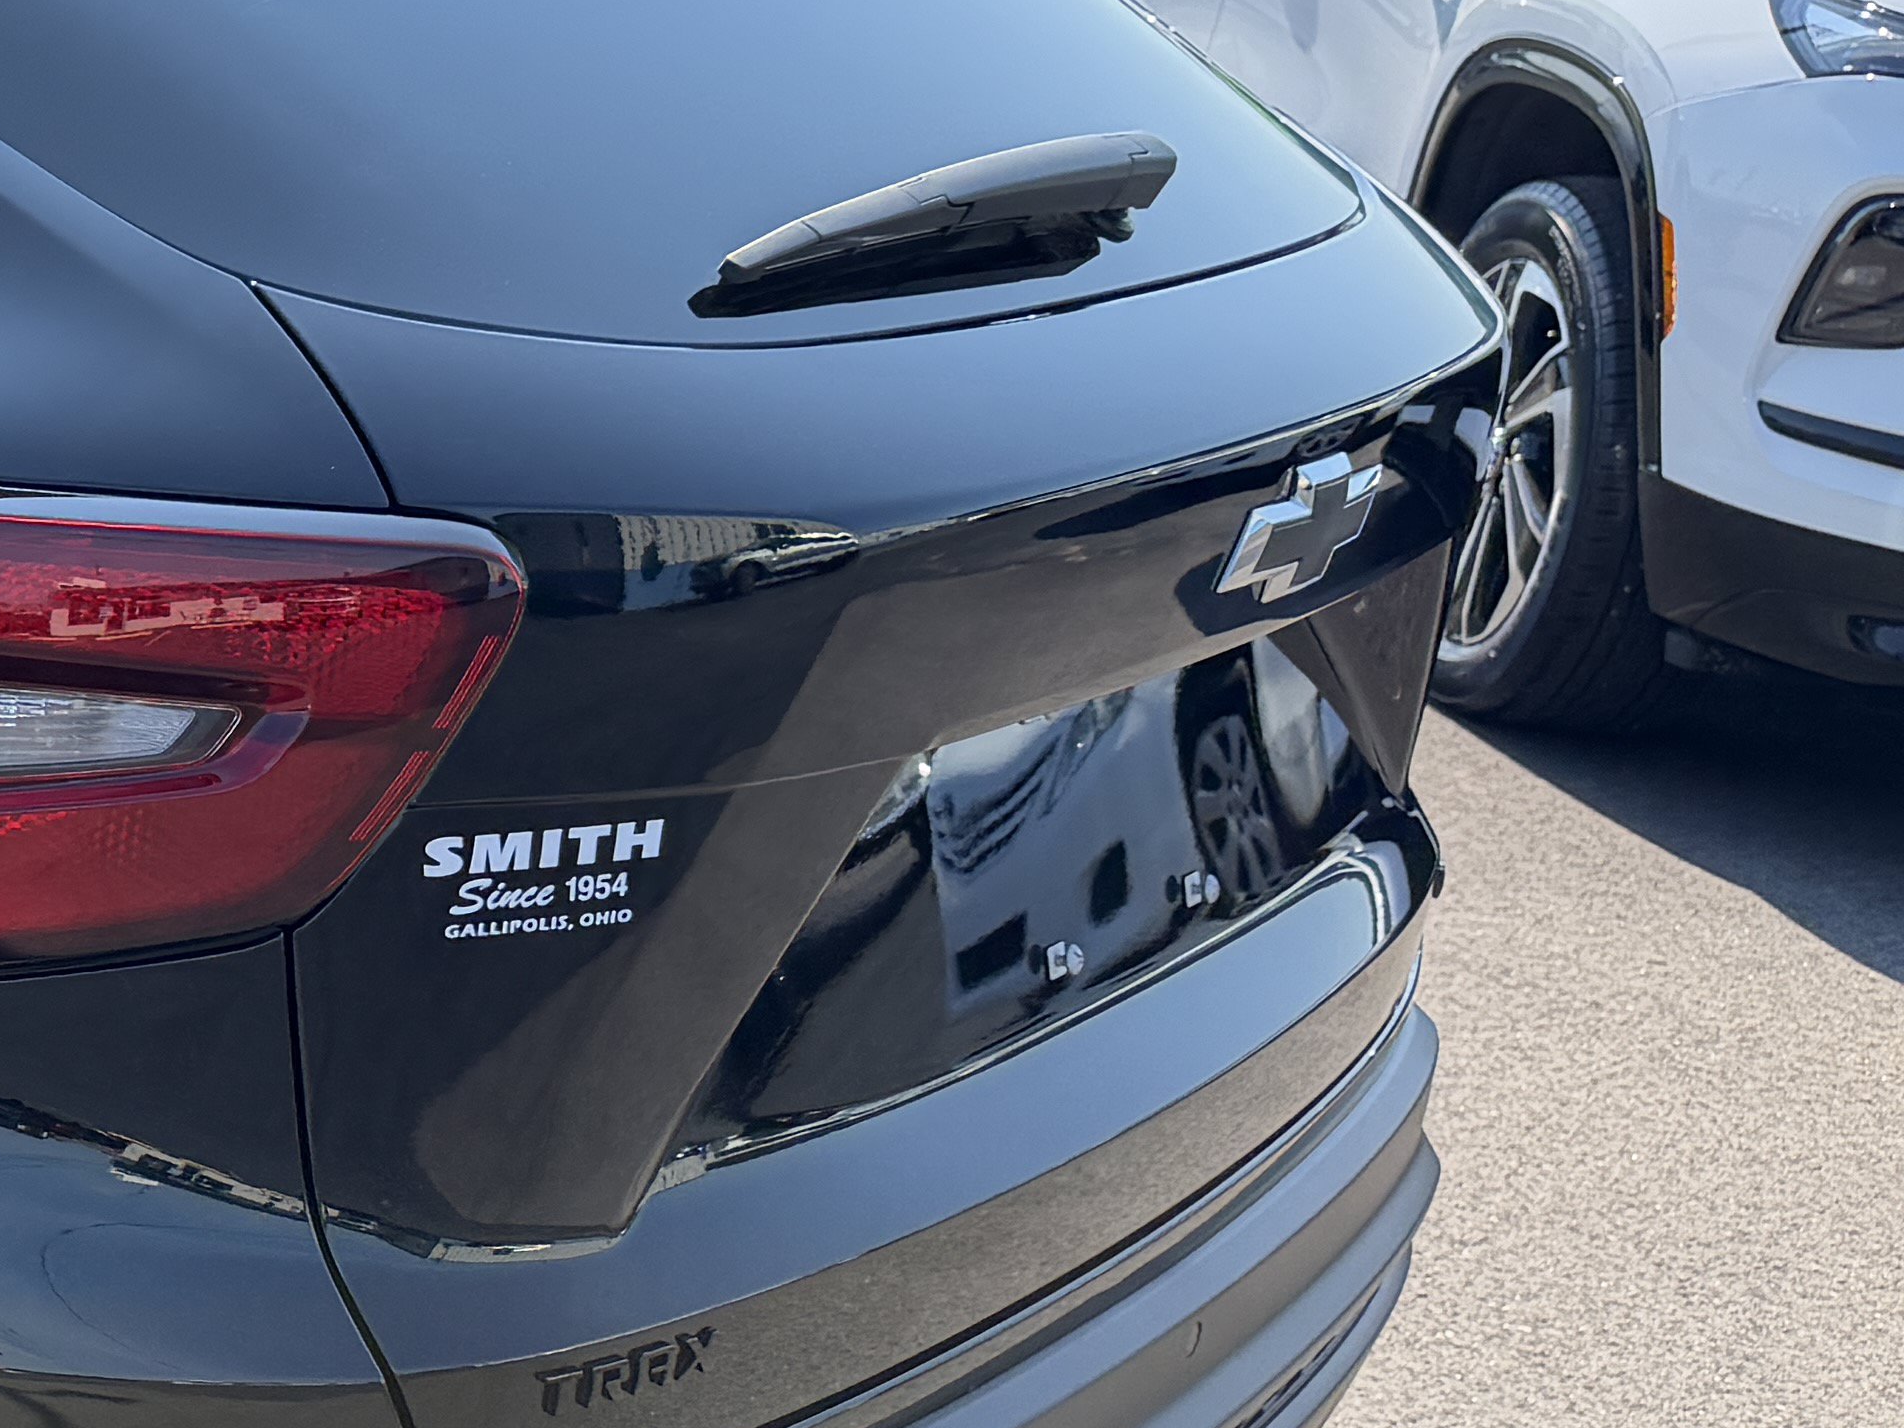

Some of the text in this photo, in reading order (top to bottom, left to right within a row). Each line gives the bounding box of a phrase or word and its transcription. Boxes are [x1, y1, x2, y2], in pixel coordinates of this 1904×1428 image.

[423, 819, 665, 877] SMITH
[449, 872, 629, 915] Since 1954
[444, 908, 633, 939] GALLIPOLIS, OHIO
